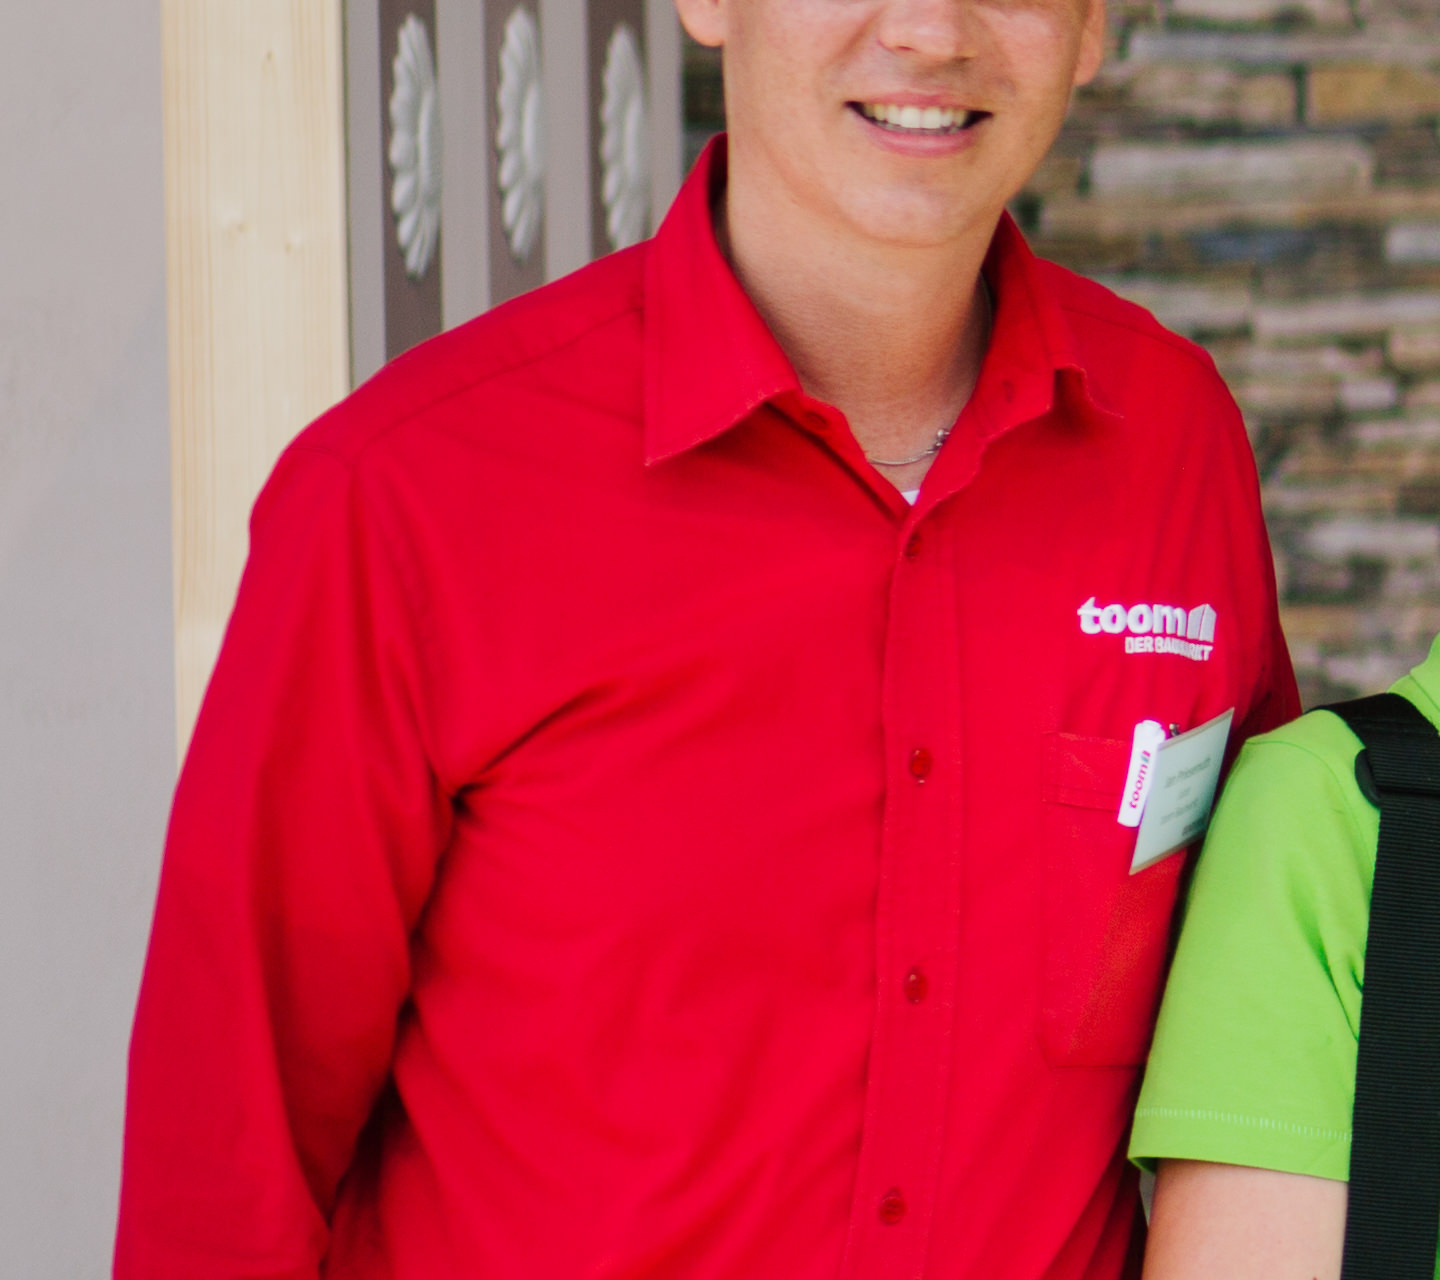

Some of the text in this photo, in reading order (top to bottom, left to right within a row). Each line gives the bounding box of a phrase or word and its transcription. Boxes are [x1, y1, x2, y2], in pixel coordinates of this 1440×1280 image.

[1077, 597, 1187, 636] toom
[1125, 636, 1153, 653] DER
[1129, 763, 1149, 809] toom
